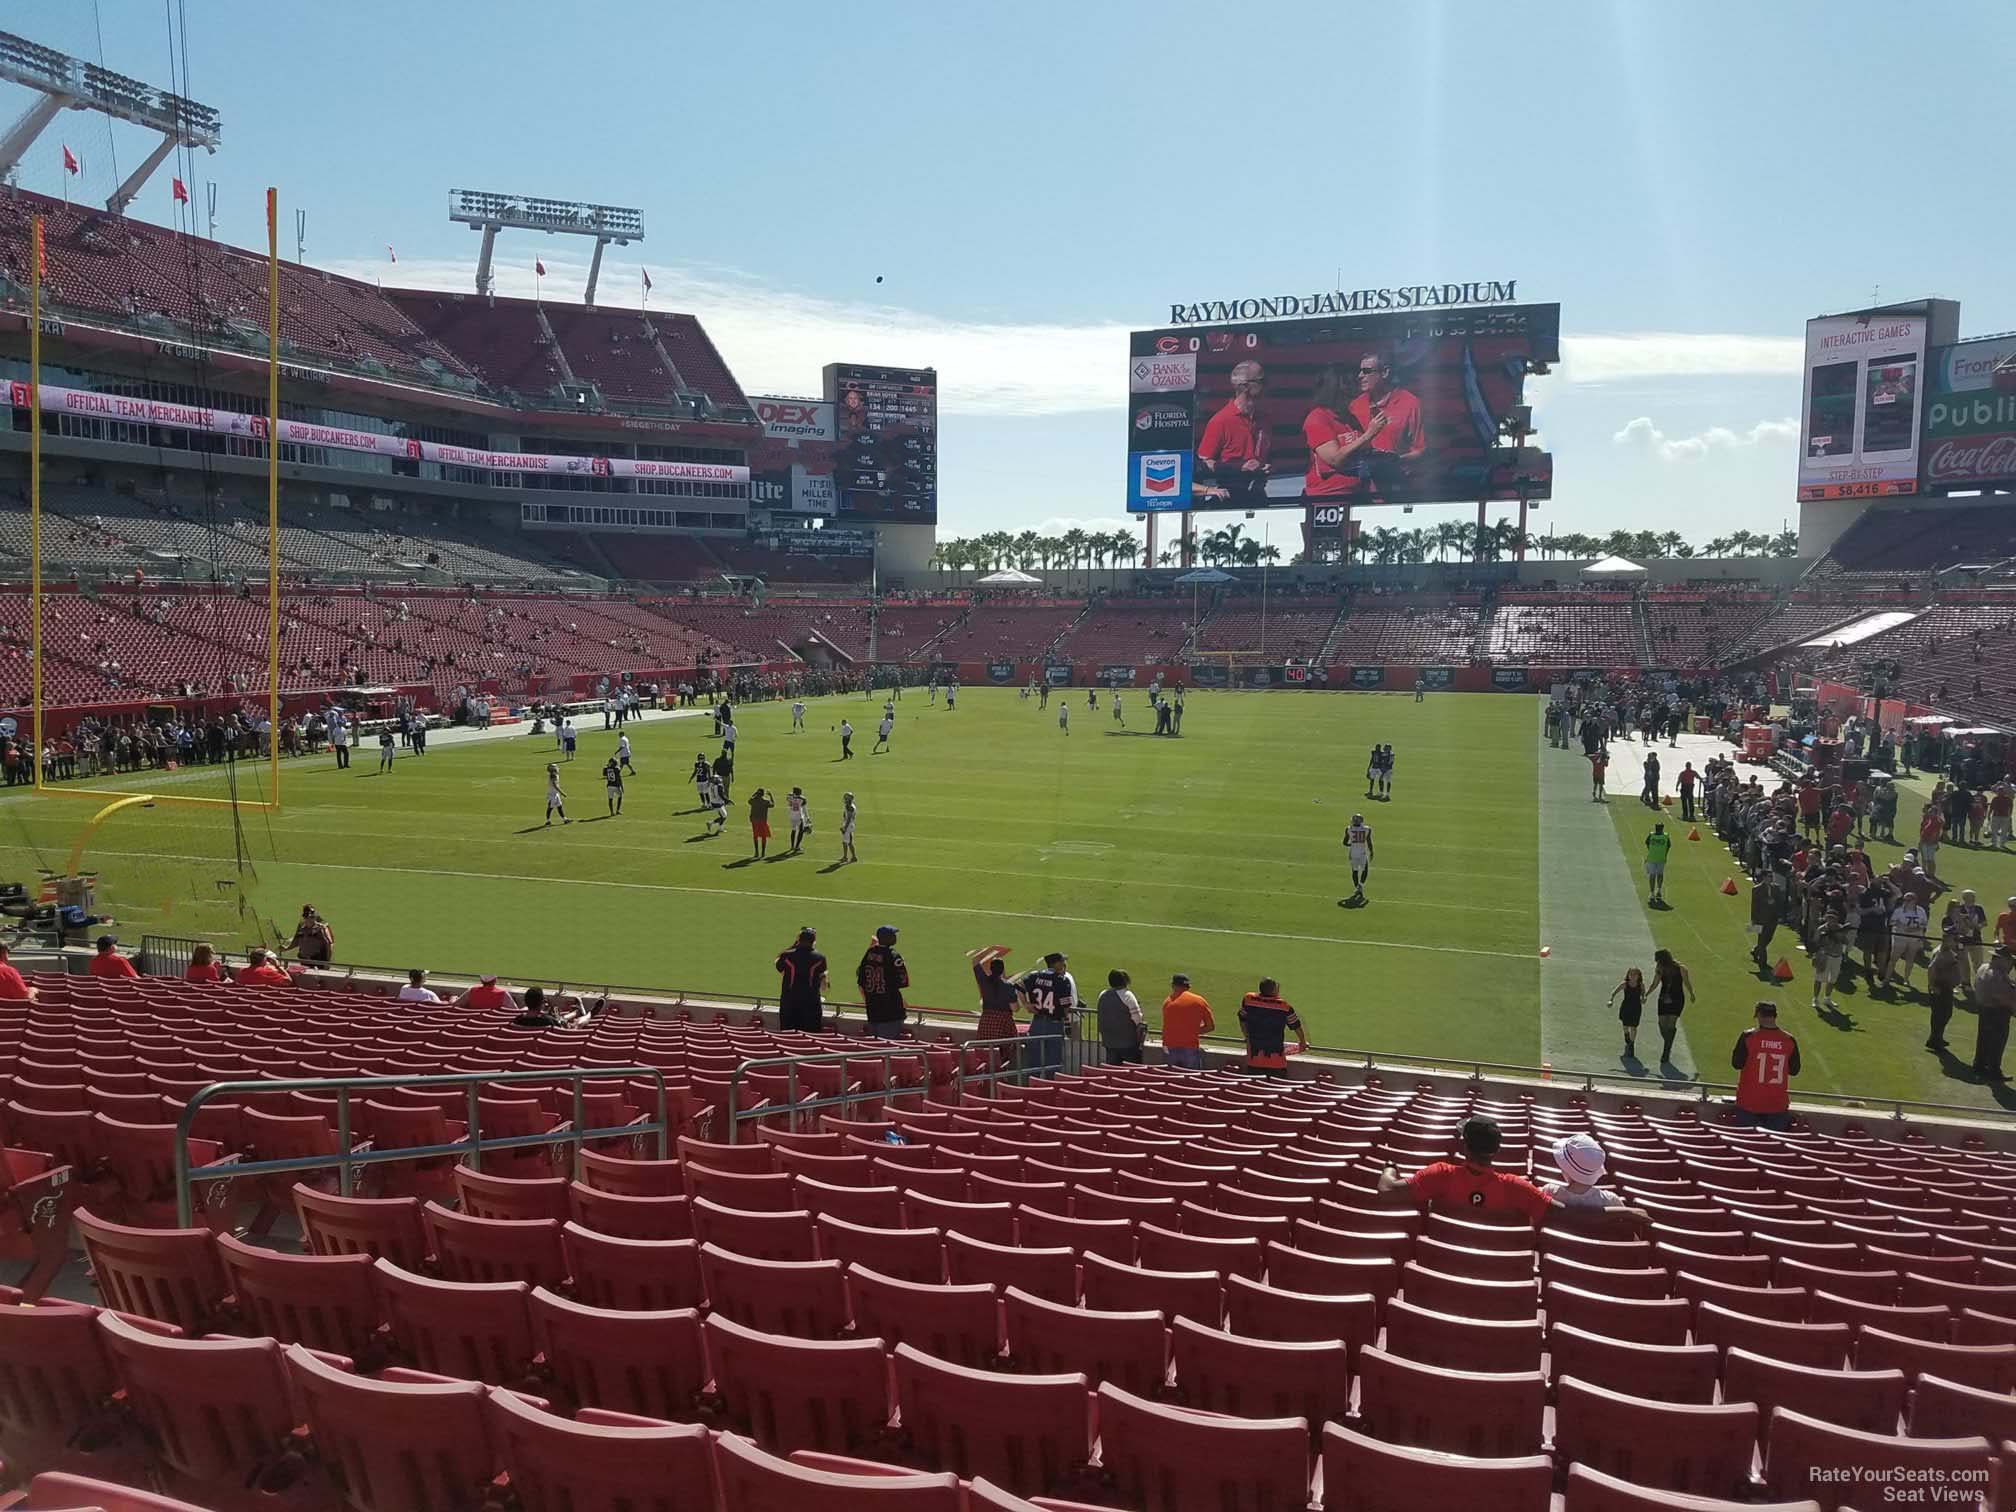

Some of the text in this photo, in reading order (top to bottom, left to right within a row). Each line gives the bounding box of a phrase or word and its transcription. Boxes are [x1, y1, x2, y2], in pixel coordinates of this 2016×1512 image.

[1170, 280, 1517, 324] RAYMOND JAMES STADIUM
[1246, 333, 1258, 348] 0
[1820, 323, 1912, 350] INTERACTIVE GAMES
[1189, 337, 1201, 352] 0
[1152, 363, 1180, 375] BANK
[1152, 374, 1190, 386] OZARKS
[66, 392, 215, 428] OFFICIAL TEAM MERCHANDISE
[758, 402, 819, 426] DEX
[1154, 410, 1188, 421] FLORIDA
[771, 424, 825, 436] imaging
[1154, 419, 1191, 429] HOSPITAL
[289, 424, 376, 449] SHOP.BUCCANEERS.COM
[438, 447, 549, 470] OFFICIAL TEAM MERCHANDISE
[1146, 458, 1176, 466] Chevron
[634, 463, 733, 479] SHOP.BUCCANEERS.COM
[802, 488, 833, 498] MILLER
[808, 499, 828, 508] TIME
[1316, 508, 1338, 523] 40
[1288, 669, 1304, 681] 40
[1032, 988, 1055, 1015] 34
[1756, 1053, 1786, 1084] 13
